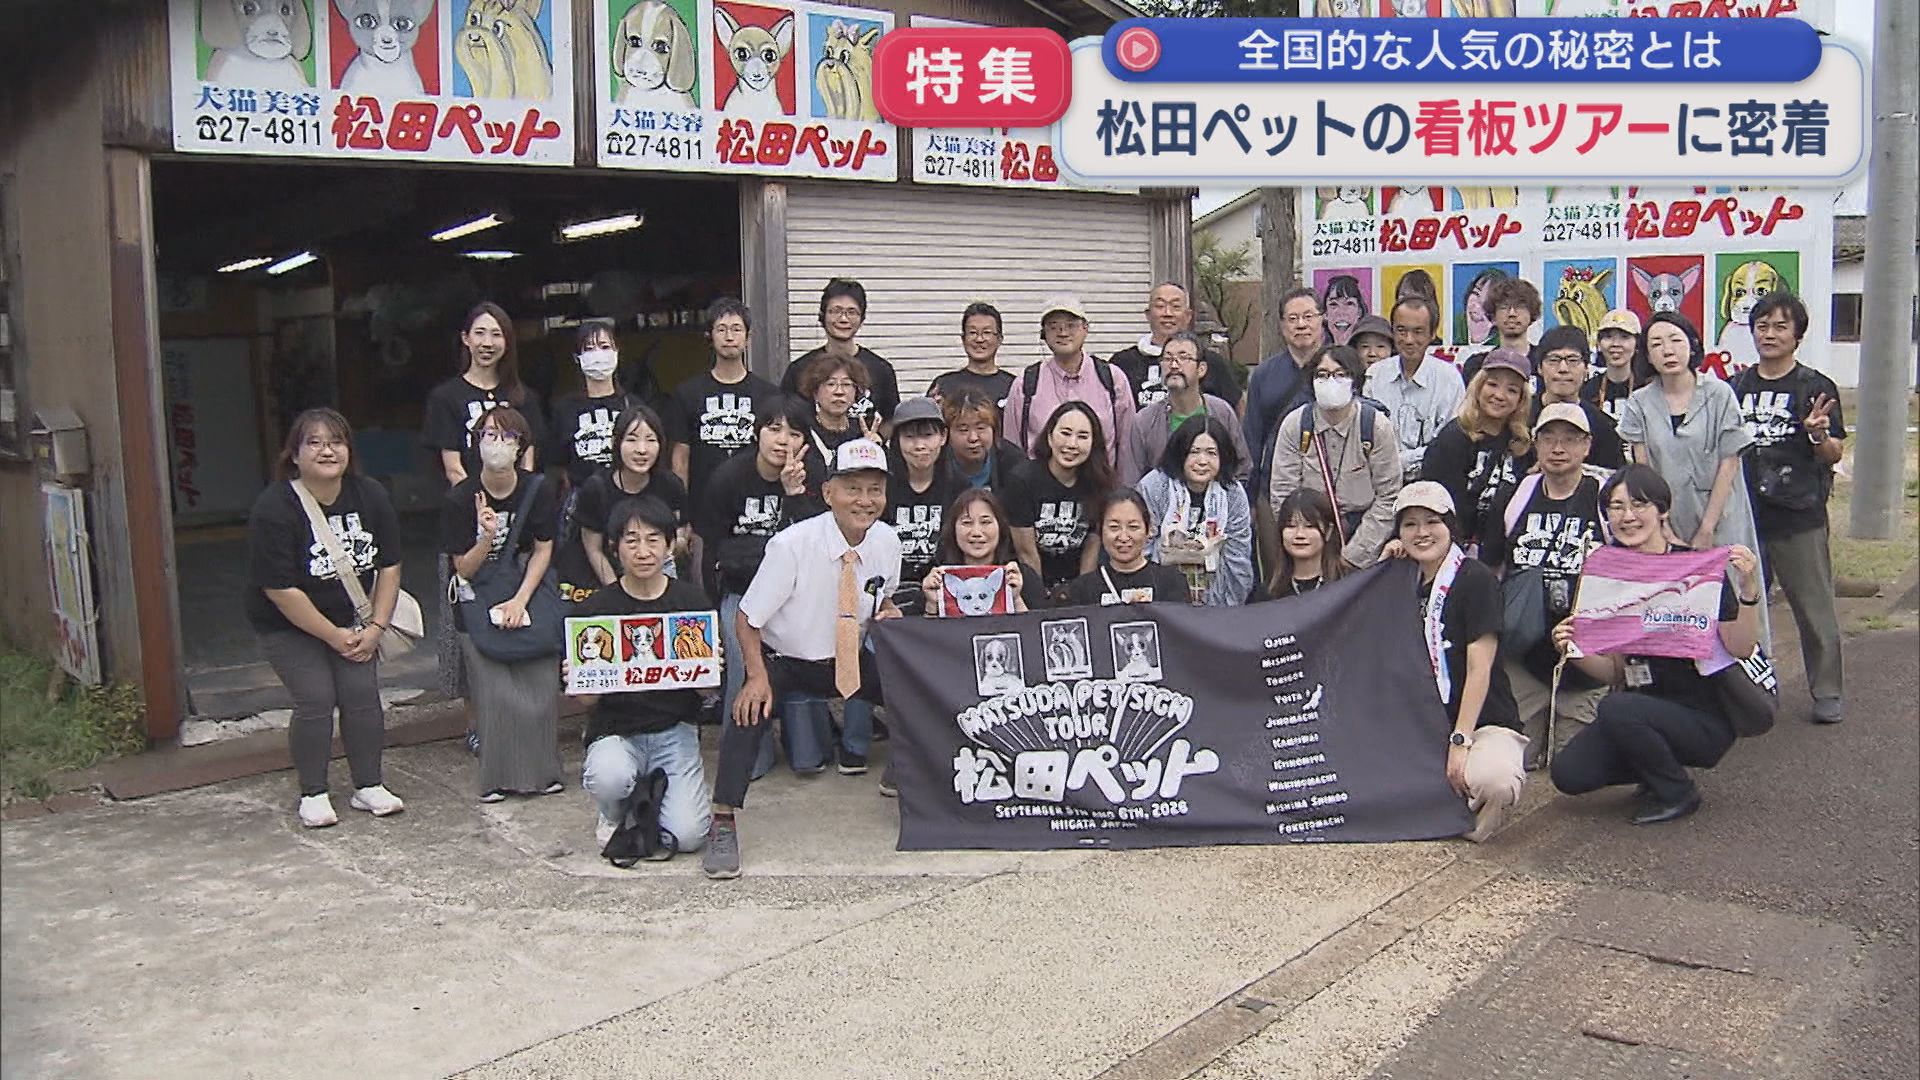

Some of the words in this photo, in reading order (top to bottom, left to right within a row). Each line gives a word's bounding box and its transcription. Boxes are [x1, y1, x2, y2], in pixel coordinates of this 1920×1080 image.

[195, 85, 321, 117] 犬猫美容
[331, 94, 562, 156] 松田ペット
[610, 108, 704, 132] 犬猫美容
[716, 118, 888, 171] 松田ペット
[926, 133, 997, 157] 犬猫美容
[1544, 202, 1621, 221] 犬猫美容
[1624, 196, 1805, 242] 松田ペット
[1313, 218, 1376, 236] 犬猫美容
[1378, 212, 1523, 253] 松田ペット
[624, 664, 711, 686] 松田ペット
[958, 685, 1073, 737] MATSUDA
[1077, 681, 1126, 709] PET
[1130, 684, 1190, 723] SIGN
[1043, 713, 1110, 742] TOUR
[953, 738, 1220, 804] 松田ペット
[1051, 818, 1096, 831] NIIGATA
